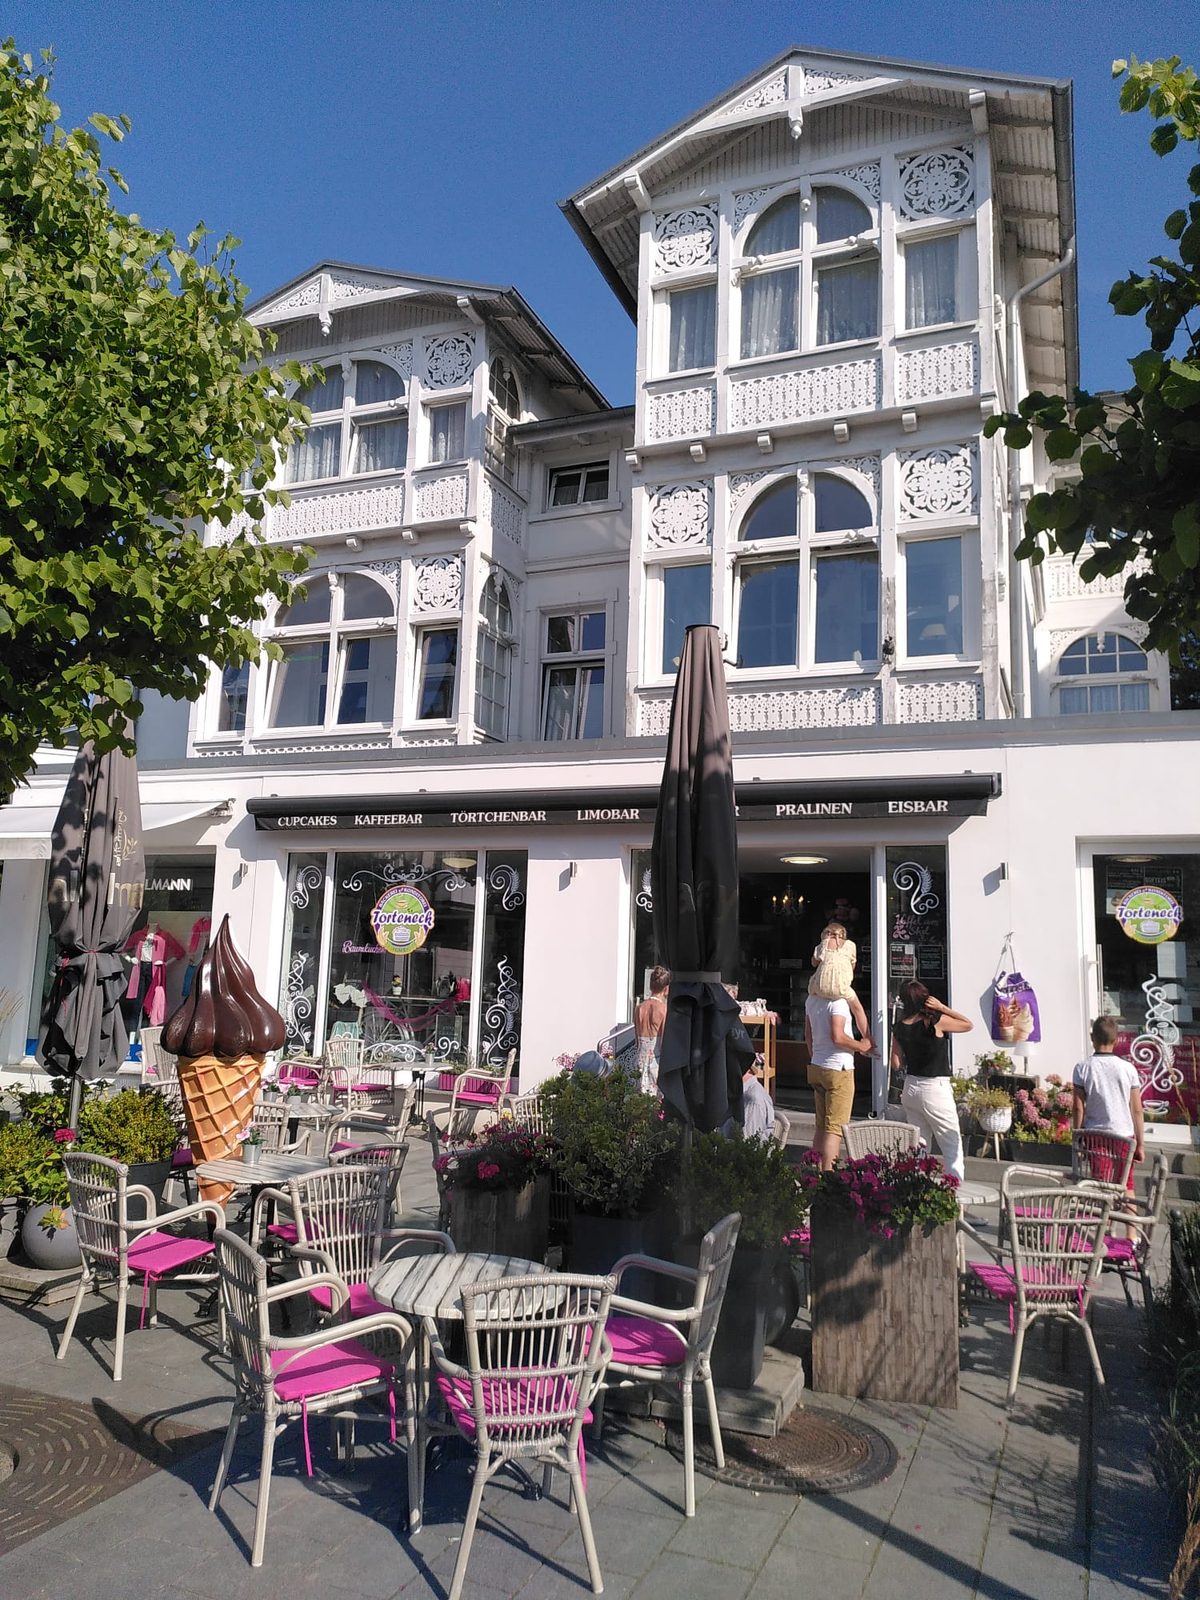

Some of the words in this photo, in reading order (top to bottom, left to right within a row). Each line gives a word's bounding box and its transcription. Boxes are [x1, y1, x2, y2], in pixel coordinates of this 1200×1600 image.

[277, 814, 338, 828] CUPCAKES
[353, 813, 423, 826] KAFFEEBAR
[450, 809, 547, 824] TÖRTCHENBAR
[576, 808, 641, 821] LIMOBAR
[775, 803, 853, 817] PRALINEN
[887, 800, 949, 814] EISBAR
[372, 909, 433, 927] Torteneck
[1116, 906, 1183, 921] Torteneck
